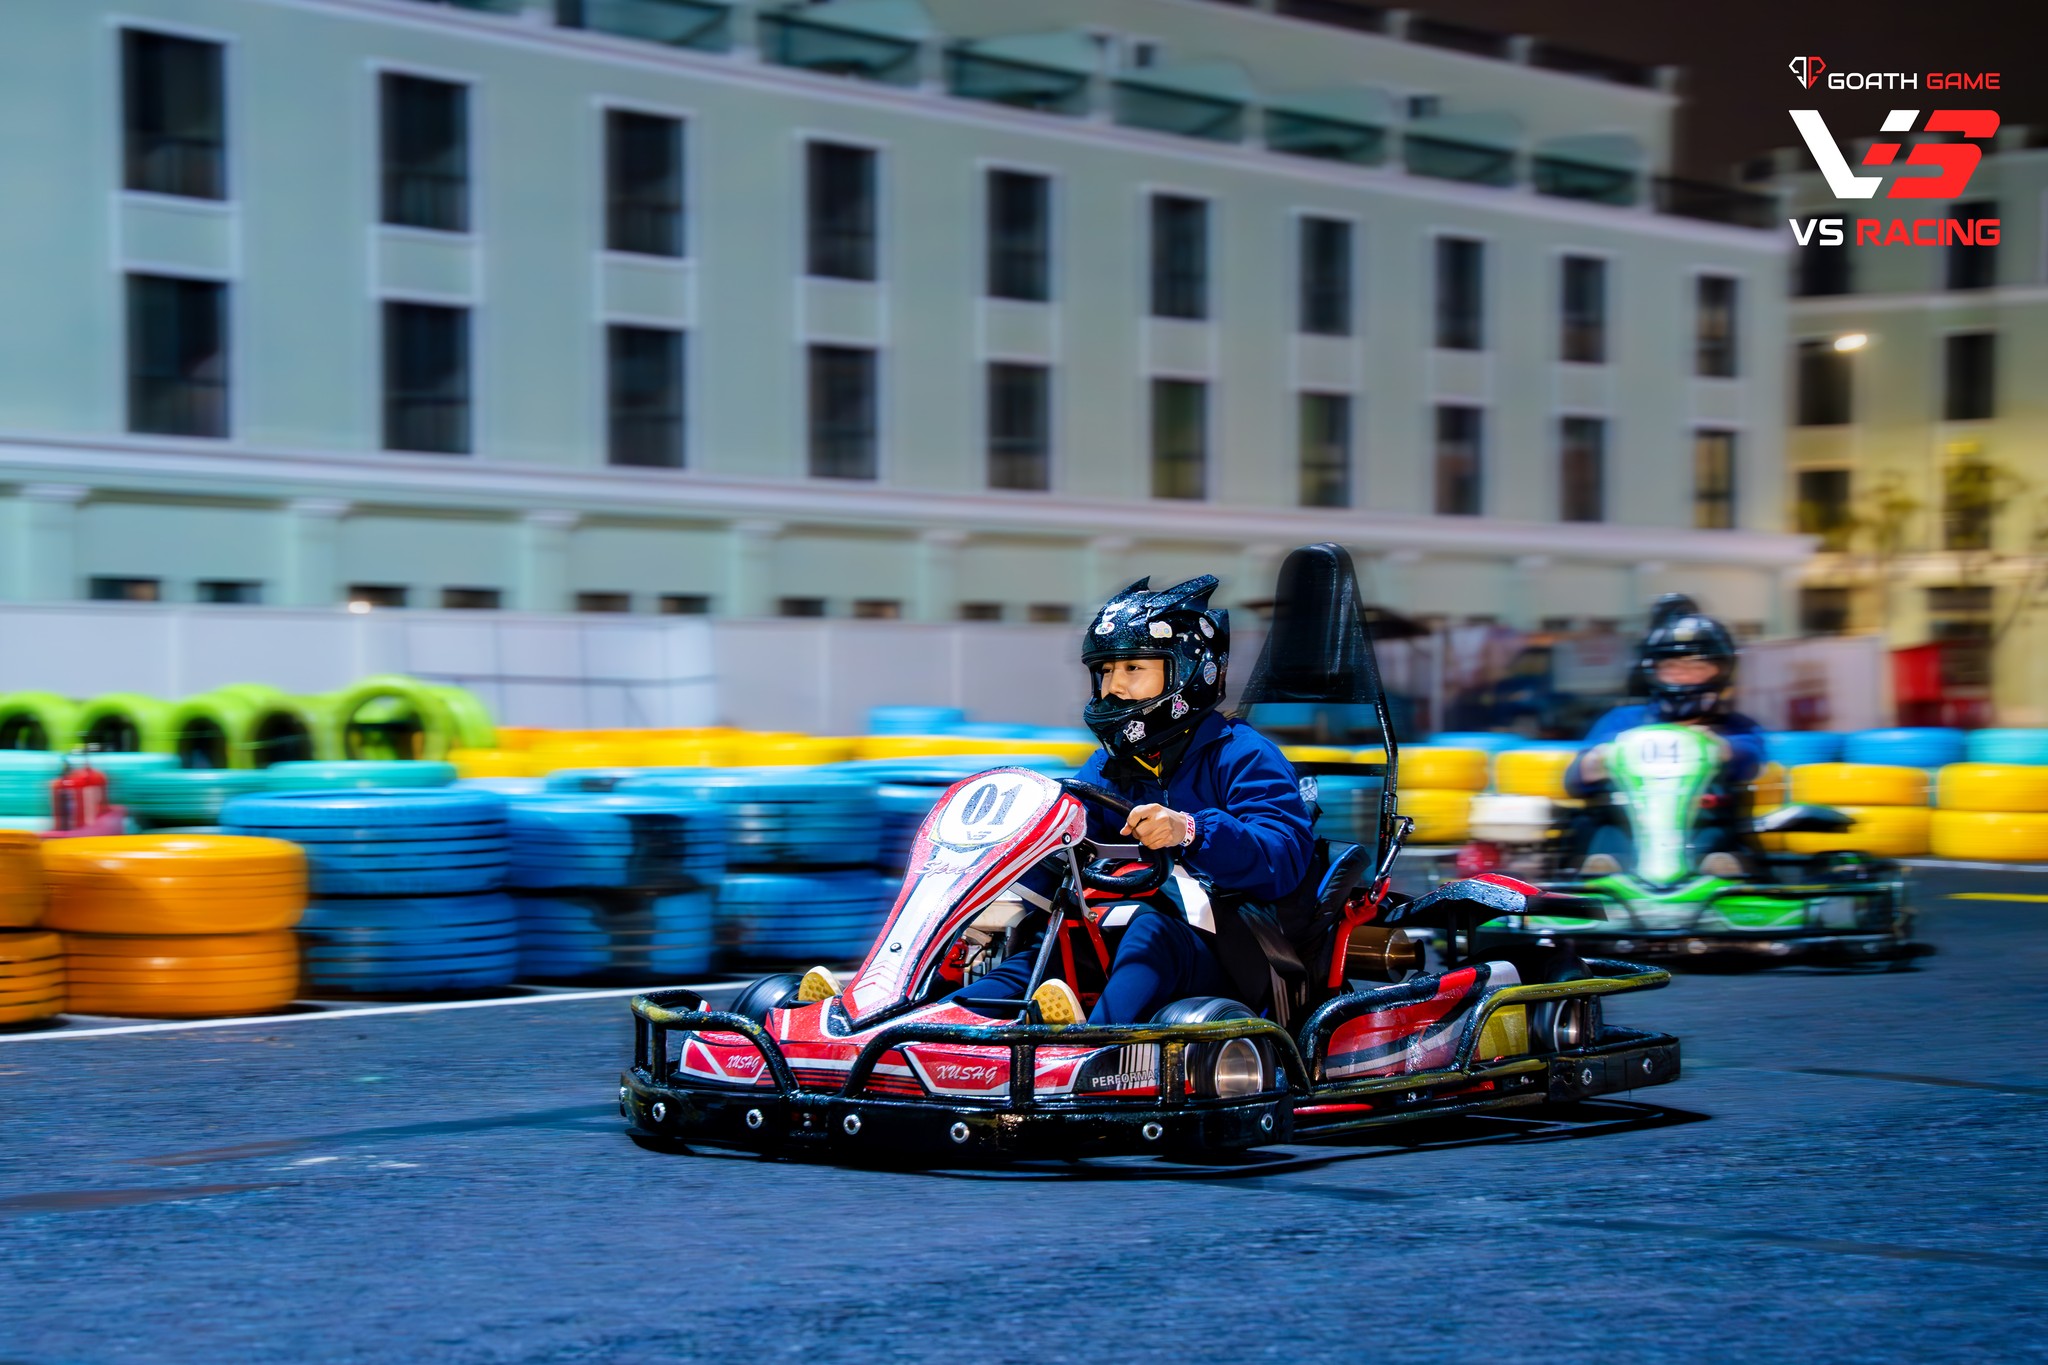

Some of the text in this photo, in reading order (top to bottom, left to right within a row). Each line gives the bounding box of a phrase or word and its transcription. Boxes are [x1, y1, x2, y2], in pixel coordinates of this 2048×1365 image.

[1641, 739, 1681, 764] 04
[961, 783, 1023, 825] 01
[936, 1065, 998, 1085] XUSHG
